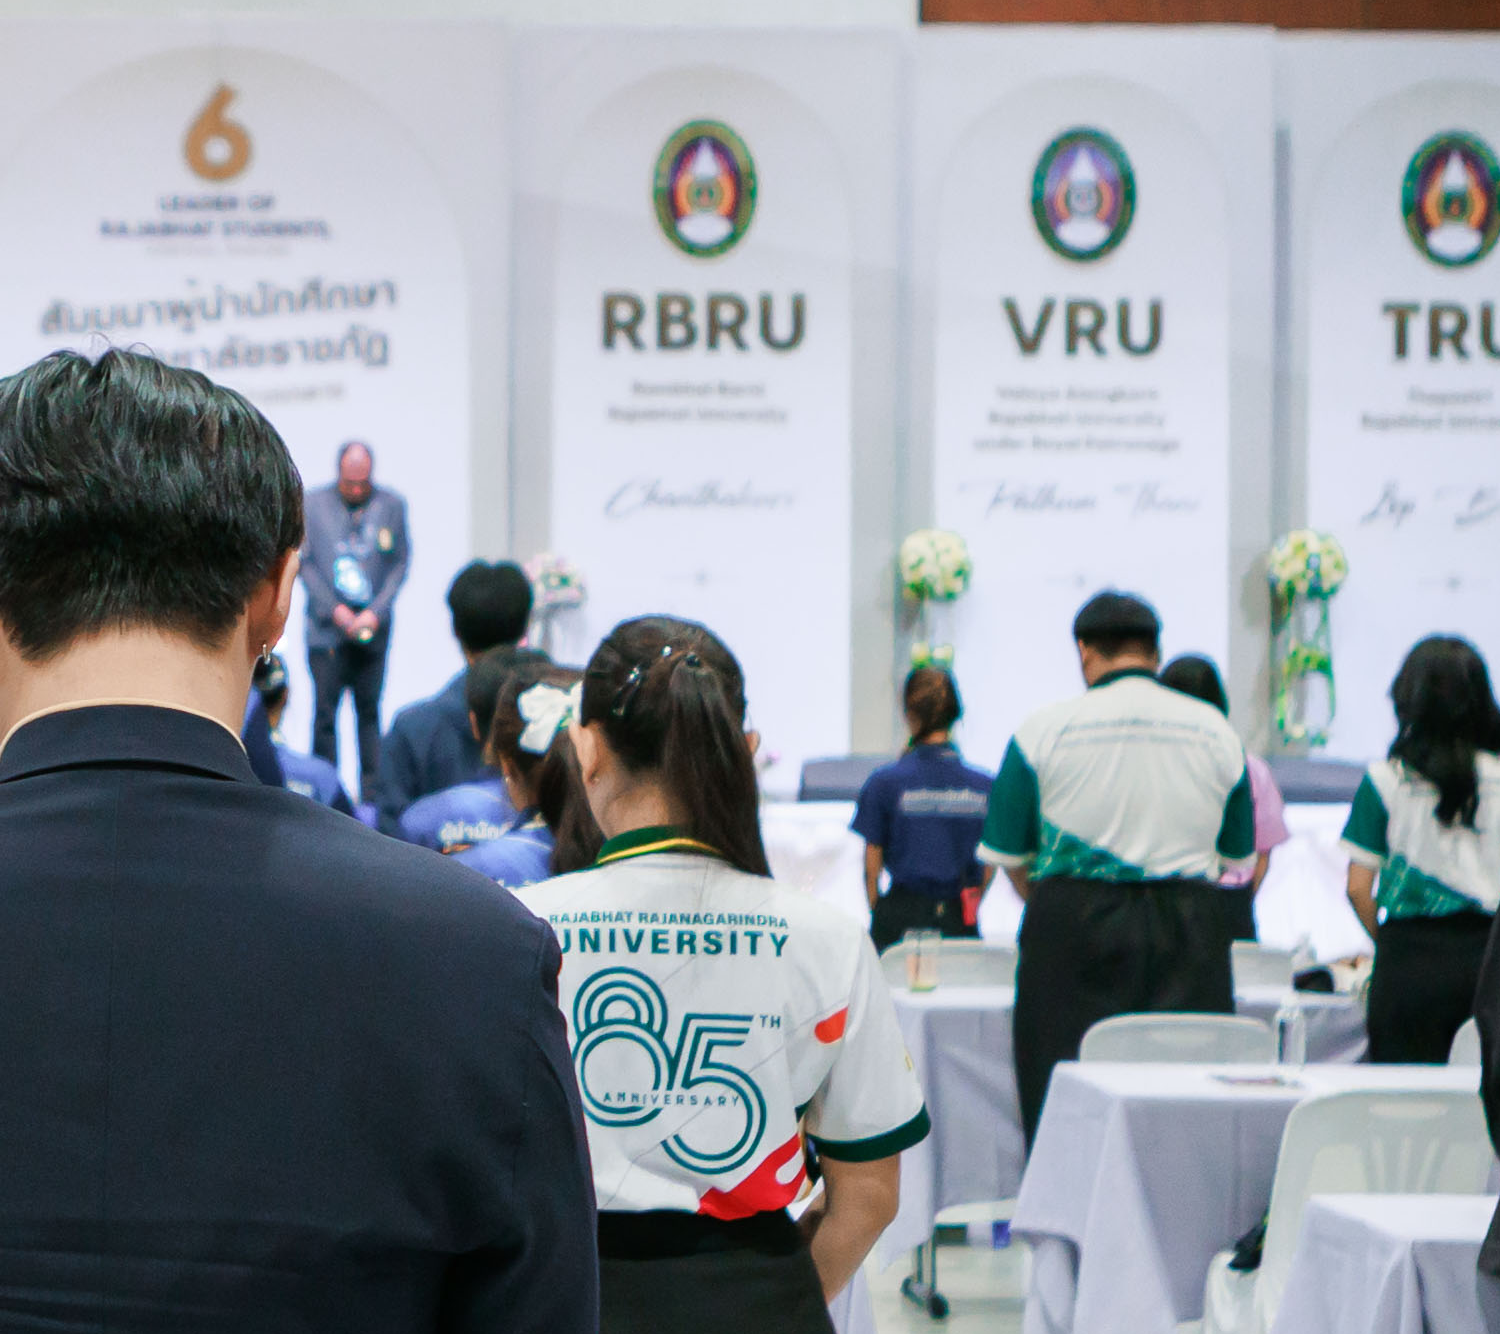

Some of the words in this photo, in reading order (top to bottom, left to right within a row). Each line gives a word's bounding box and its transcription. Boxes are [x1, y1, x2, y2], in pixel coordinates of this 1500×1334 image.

[183, 82, 252, 184] 6
[602, 290, 807, 352] RBRU
[1002, 296, 1164, 357] VRU
[548, 910, 633, 925] RAJABHAT
[638, 911, 789, 929] RAJANAGARINDRA
[759, 1014, 782, 1030] TH
[571, 966, 767, 1175] 85
[602, 1091, 743, 1107] ANNIVERSARY
